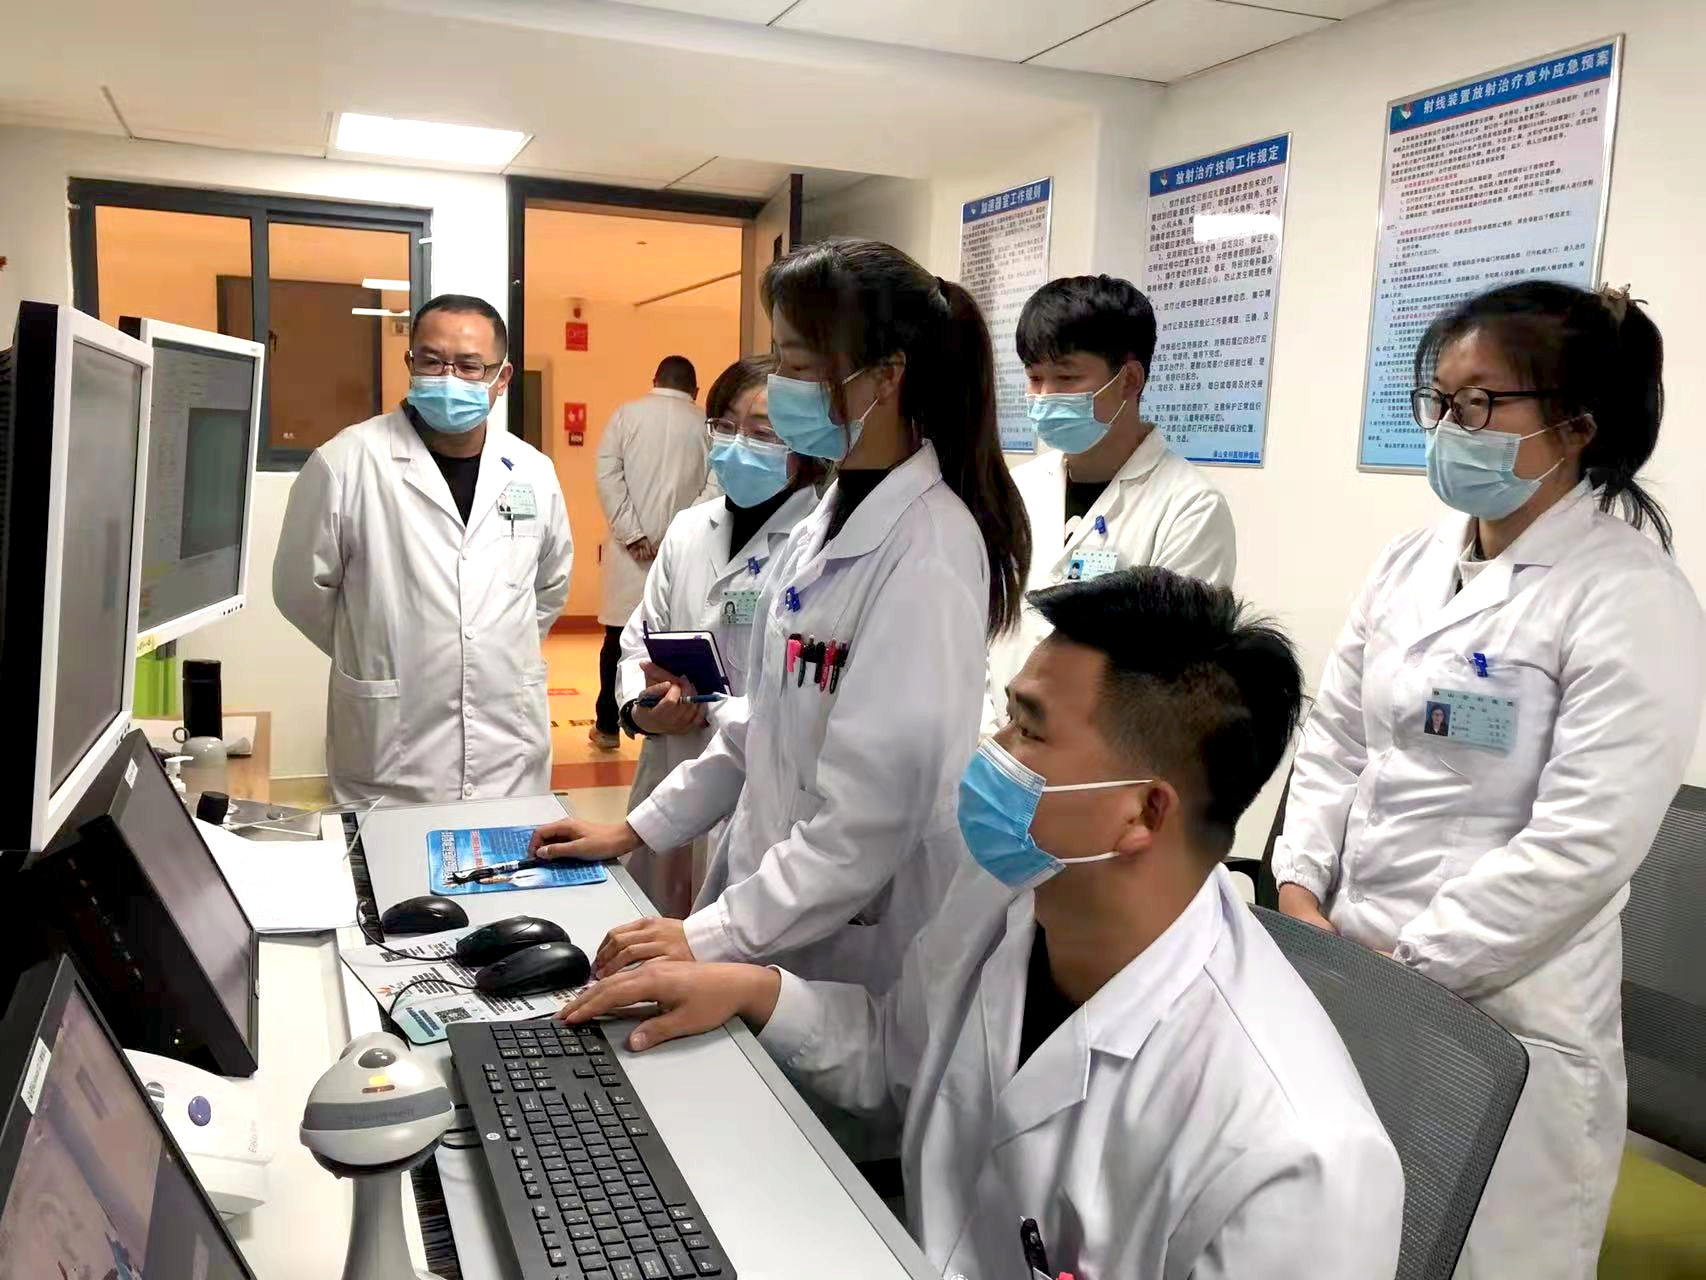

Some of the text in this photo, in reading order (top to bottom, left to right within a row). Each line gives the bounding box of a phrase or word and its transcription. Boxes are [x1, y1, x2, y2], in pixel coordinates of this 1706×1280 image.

[1423, 49, 1610, 114] 射线装置放射治疗意外应急预案
[1175, 145, 1279, 185] 放射治疗技师工作规定
